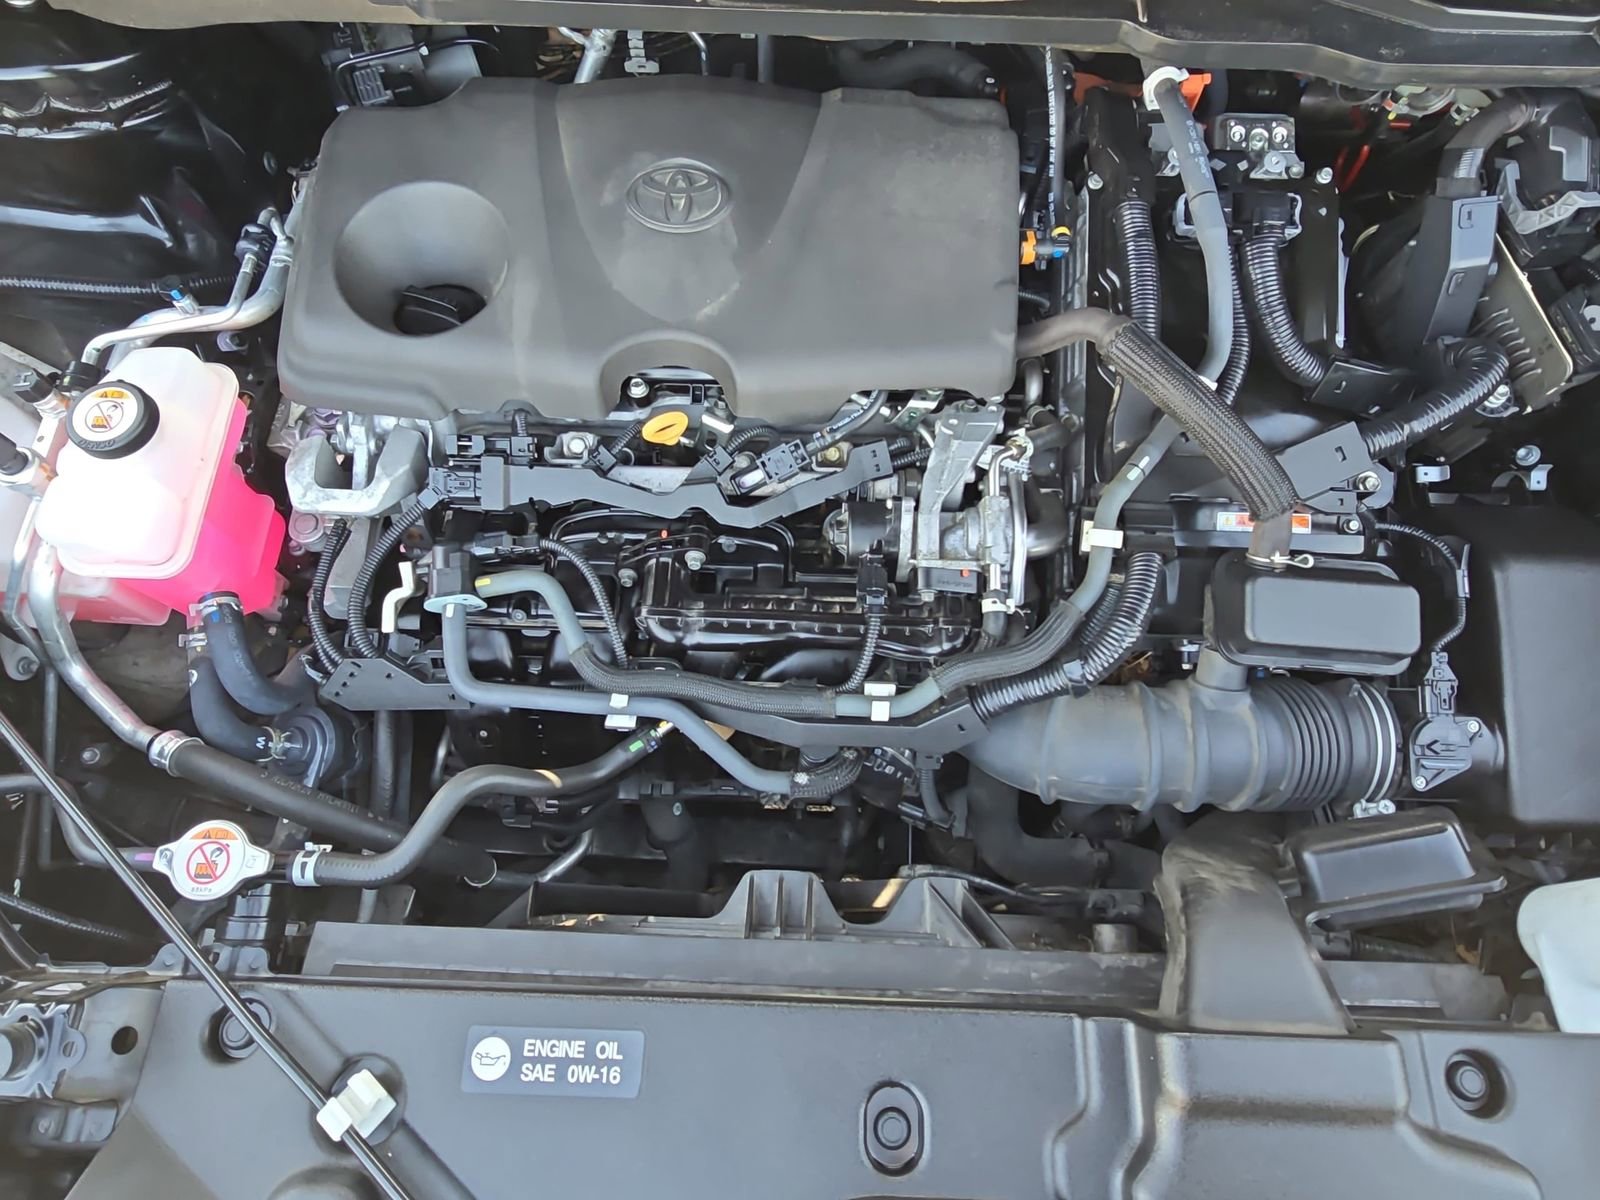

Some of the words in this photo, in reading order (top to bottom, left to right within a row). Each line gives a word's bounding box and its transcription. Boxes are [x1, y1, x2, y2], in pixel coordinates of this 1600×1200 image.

[523, 1038, 586, 1058] ENGINE
[595, 1041, 623, 1060] OIL
[520, 1063, 556, 1082] SAE
[567, 1064, 621, 1084] 0W-16
